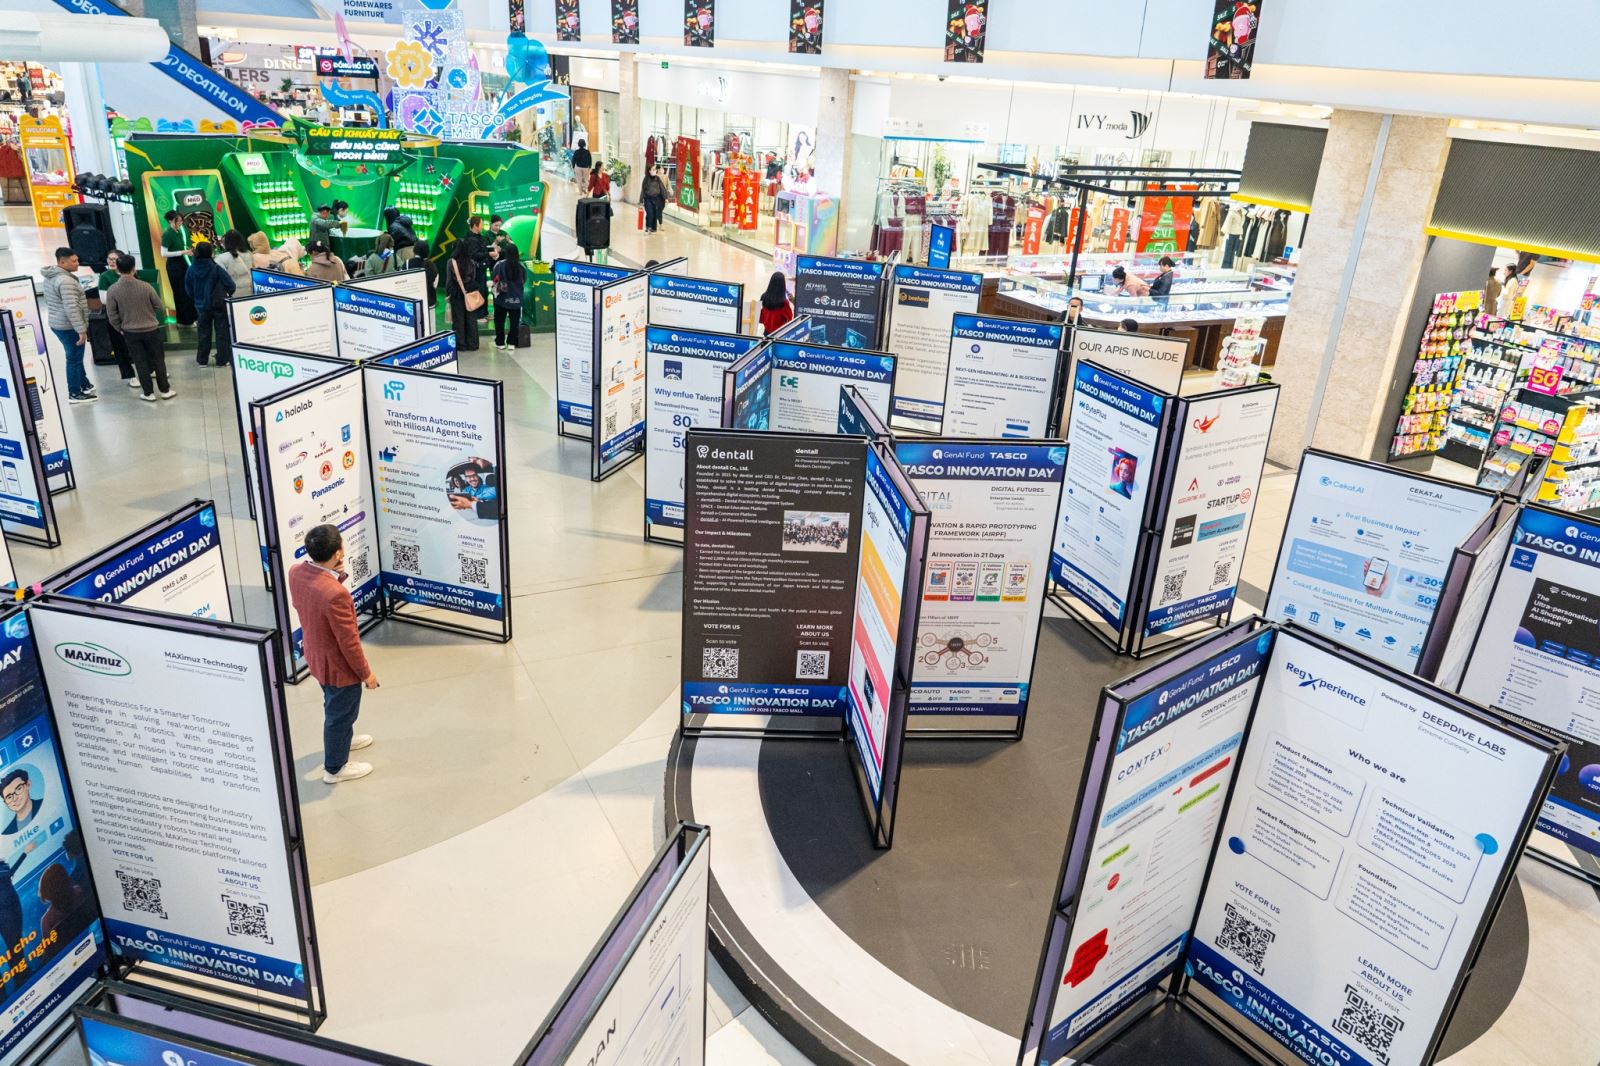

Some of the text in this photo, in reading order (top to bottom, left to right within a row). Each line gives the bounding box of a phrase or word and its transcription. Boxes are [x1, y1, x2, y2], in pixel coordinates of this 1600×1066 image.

[344, 9, 384, 18] FURNITURE
[177, 62, 247, 114] DECATHLON
[449, 113, 504, 126] TASCO
[1077, 114, 1128, 131] IVY moda
[452, 128, 480, 139] Mall
[823, 270, 862, 279] INNOVATION
[899, 277, 920, 286] TASCO
[921, 279, 960, 290] INNOVATION
[339, 303, 411, 324] TASCO INNOVATION DAY
[957, 328, 1054, 347] TASCO INNOVATION DAY
[653, 344, 735, 360] TASCO INNOVATION
[1079, 341, 1179, 363] OUR APIS INCLUDE
[778, 358, 886, 381] TASCO INNOVATION DAY
[654, 388, 671, 397] Why
[673, 390, 694, 400] enfue
[285, 399, 313, 418] hololab
[387, 409, 477, 430] Transform Automotive
[672, 414, 692, 427] 80
[404, 423, 434, 433] HiliosAI
[436, 427, 459, 437] Agent
[462, 431, 482, 441] Suite
[711, 448, 754, 460] dentall
[903, 464, 1055, 478] TASCO INNOVATION DAY
[311, 476, 345, 500] Panasonic
[1409, 487, 1443, 500] CEKAT.AI
[1207, 493, 1240, 510] STARTUP
[1345, 512, 1420, 538] Real Business Impact
[113, 533, 211, 601] INNOVATION DAY
[161, 573, 188, 593] DMS LAB
[387, 583, 496, 612] TASCO INNOVATION DAY
[1537, 593, 1550, 601] The
[1529, 613, 1562, 628] Assistant
[1533, 600, 1598, 625] Ultra-personalized
[1541, 610, 1572, 624] Shopping
[64, 647, 122, 669] MAXimuz
[164, 650, 248, 674] MAXimuz Technology
[64, 690, 104, 705] Pioneering
[105, 698, 138, 711] Robotics
[140, 704, 152, 713] For
[160, 708, 190, 720] Smarter
[192, 714, 230, 728] Tomorrow
[690, 695, 837, 708] TASCO INNOVATION DAY
[1128, 661, 1259, 743] TASCO INNOVATION DAY
[68, 701, 79, 710] We
[86, 704, 113, 716] believe
[133, 713, 160, 725] solving
[167, 720, 205, 734] real-world
[212, 728, 253, 742] challenges
[1422, 710, 1508, 757] DEEPDIVE LABS
[1276, 741, 1332, 774] Product Roadmap
[1348, 749, 1407, 784] Who we are
[1106, 794, 1138, 821] Traditional
[1138, 786, 1158, 801] Claims
[1382, 797, 1455, 840] Technical Validation
[13, 824, 40, 848] Mike
[1358, 864, 1397, 890] Foundation
[1234, 880, 1281, 914] VOTE FOR US
[14, 930, 37, 954] cho
[159, 934, 256, 964] GenAI Fund TASCO
[116, 935, 294, 988] TASCO INNOVATION DAY
[1195, 958, 1244, 1000] TASCO
[8, 990, 36, 1015] TASCO
[24, 993, 62, 1029] TASCO MALL
